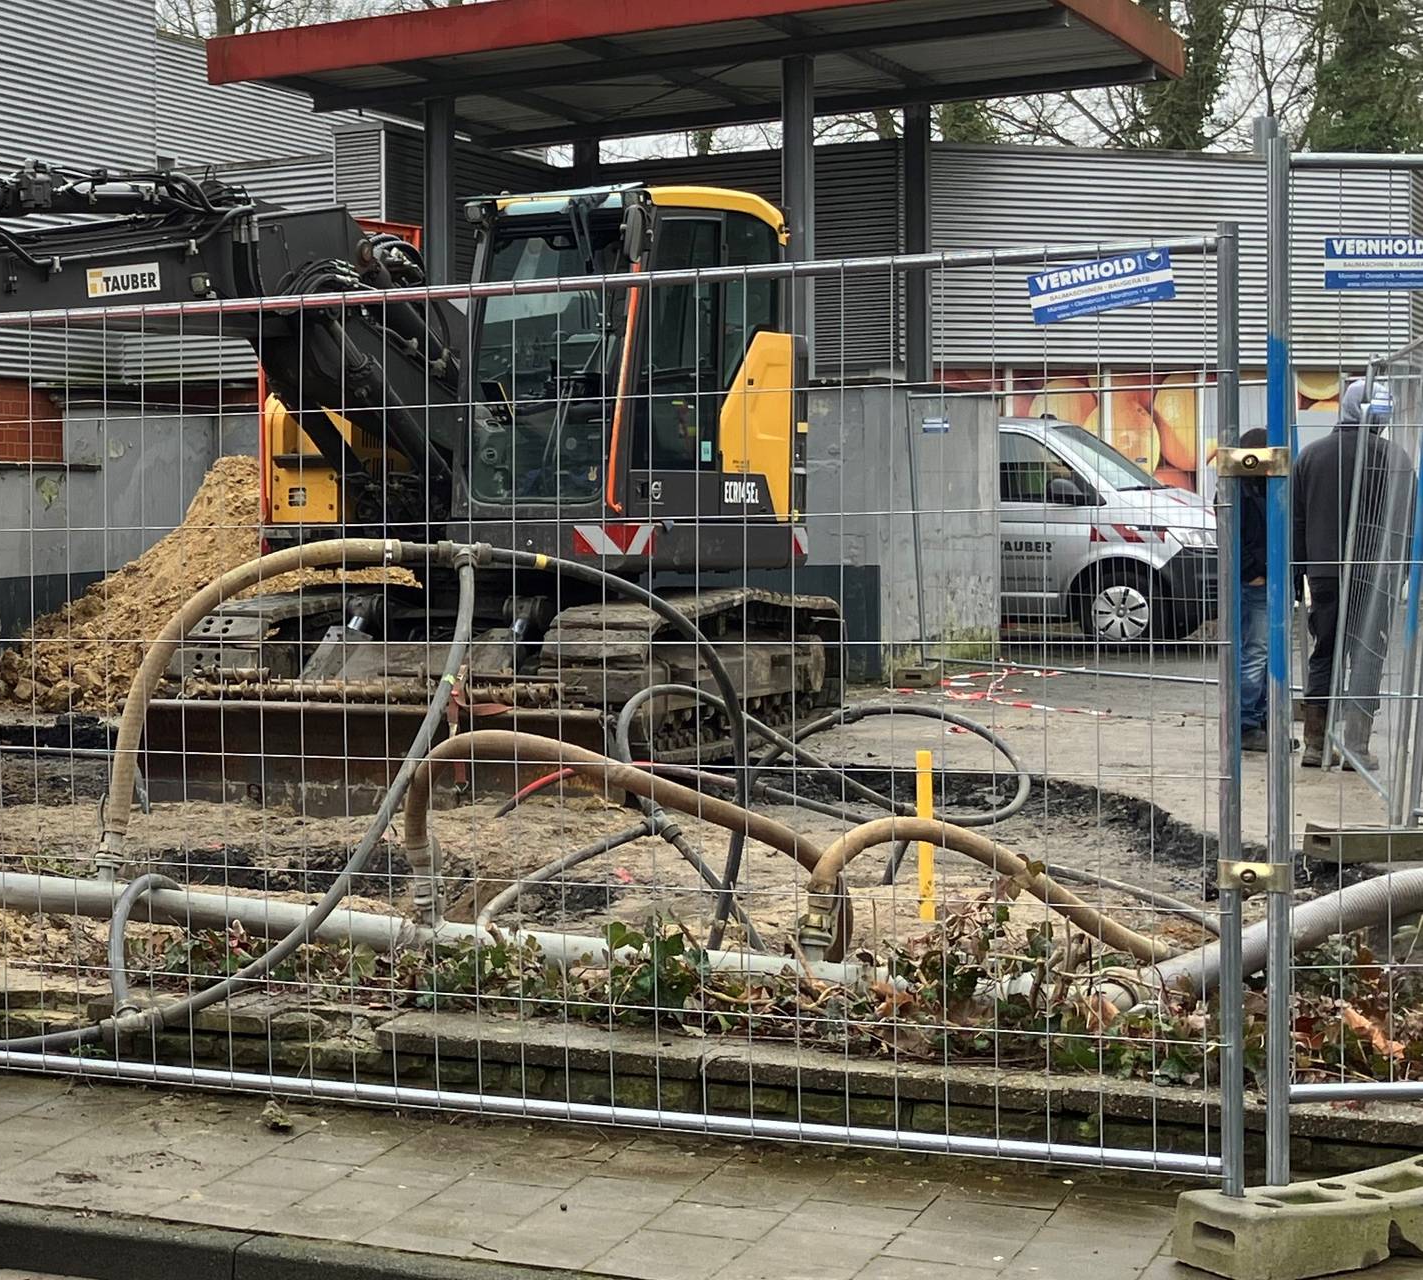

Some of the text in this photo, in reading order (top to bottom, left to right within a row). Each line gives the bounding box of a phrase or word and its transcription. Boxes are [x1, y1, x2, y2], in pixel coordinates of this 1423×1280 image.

[1332, 239, 1423, 255] VERNHOLD
[102, 271, 157, 293] TAUBER
[1034, 257, 1137, 292] VERNHOLD
[1001, 540, 1052, 553] AUBER
